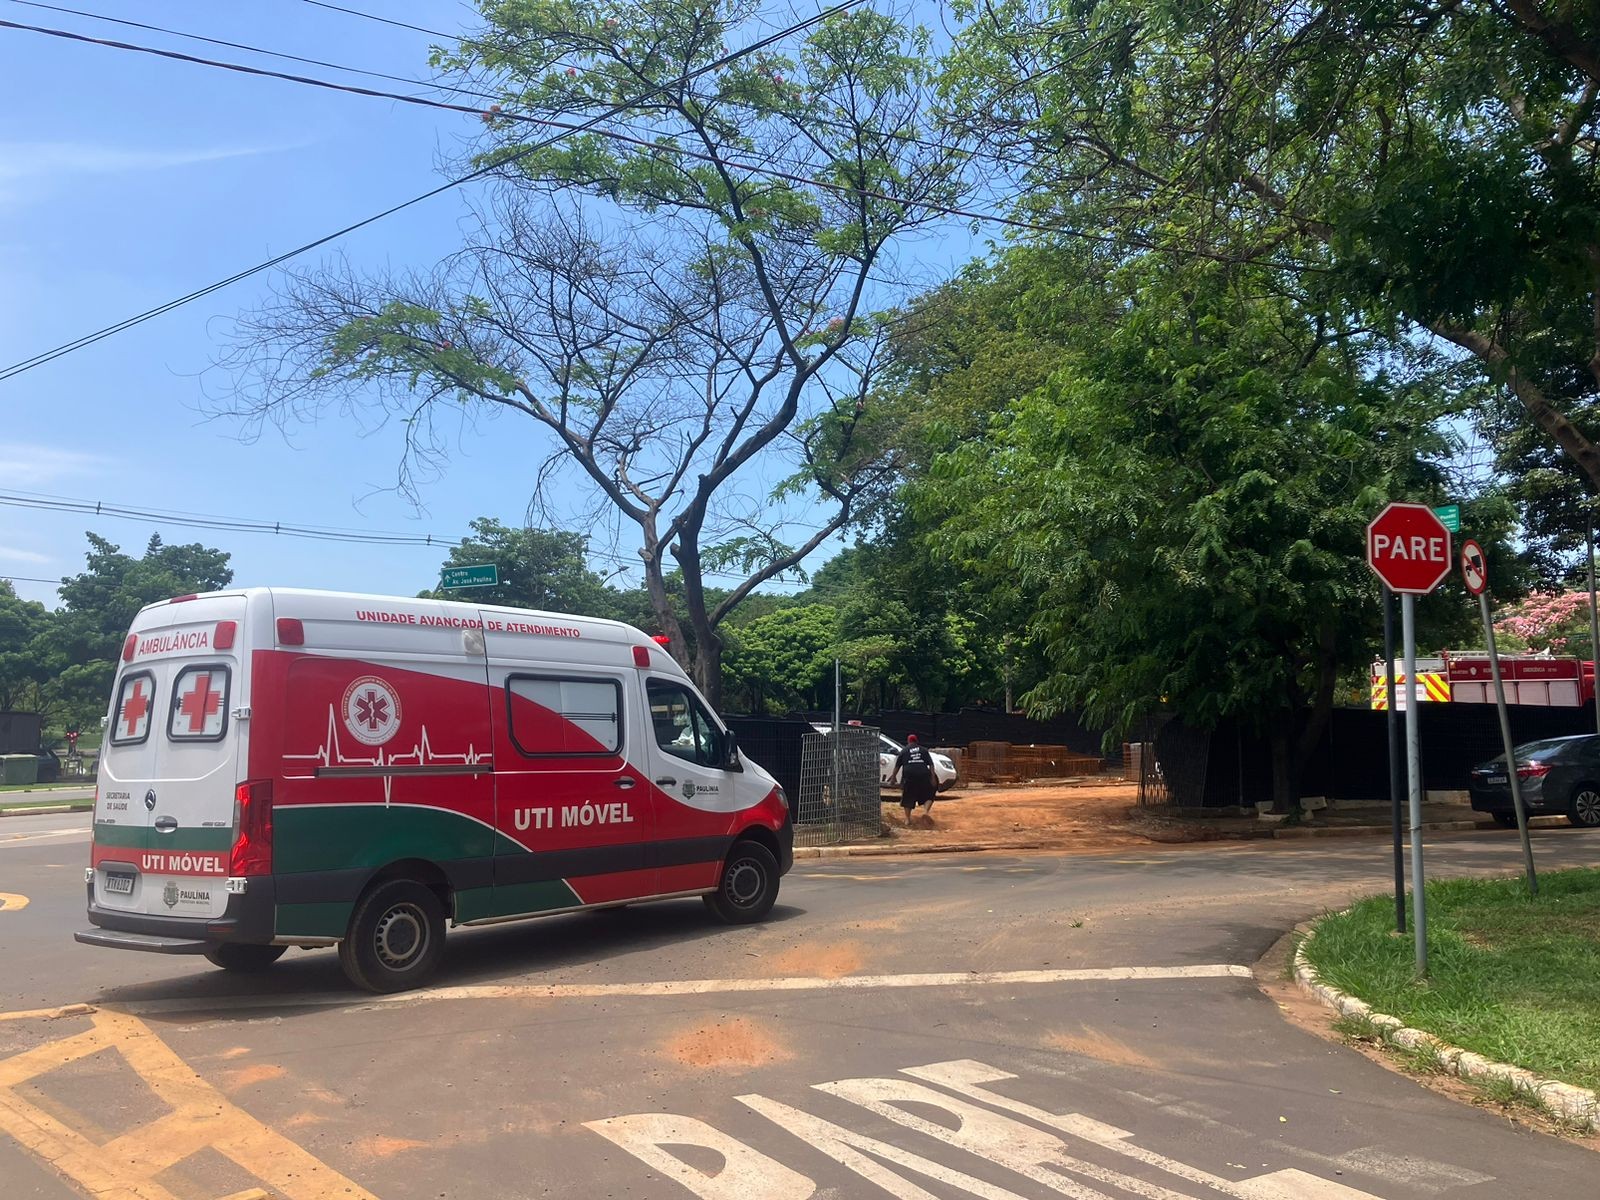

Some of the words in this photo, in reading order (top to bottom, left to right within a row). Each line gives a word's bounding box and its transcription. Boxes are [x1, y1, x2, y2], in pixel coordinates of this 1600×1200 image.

[1374, 534, 1445, 561] PARE
[356, 610, 416, 624] UNIDADE
[488, 620, 503, 631] DE
[506, 622, 581, 638] ATENDIMENTO
[138, 631, 208, 656] AMBULÂNCIA
[106, 791, 130, 800] SECRETARIA
[514, 807, 553, 831] UTI
[561, 800, 634, 828] MÓVEL
[142, 854, 165, 870] UTI
[169, 853, 224, 872] MÓVEL
[180, 889, 210, 900] PAULÍNIA
